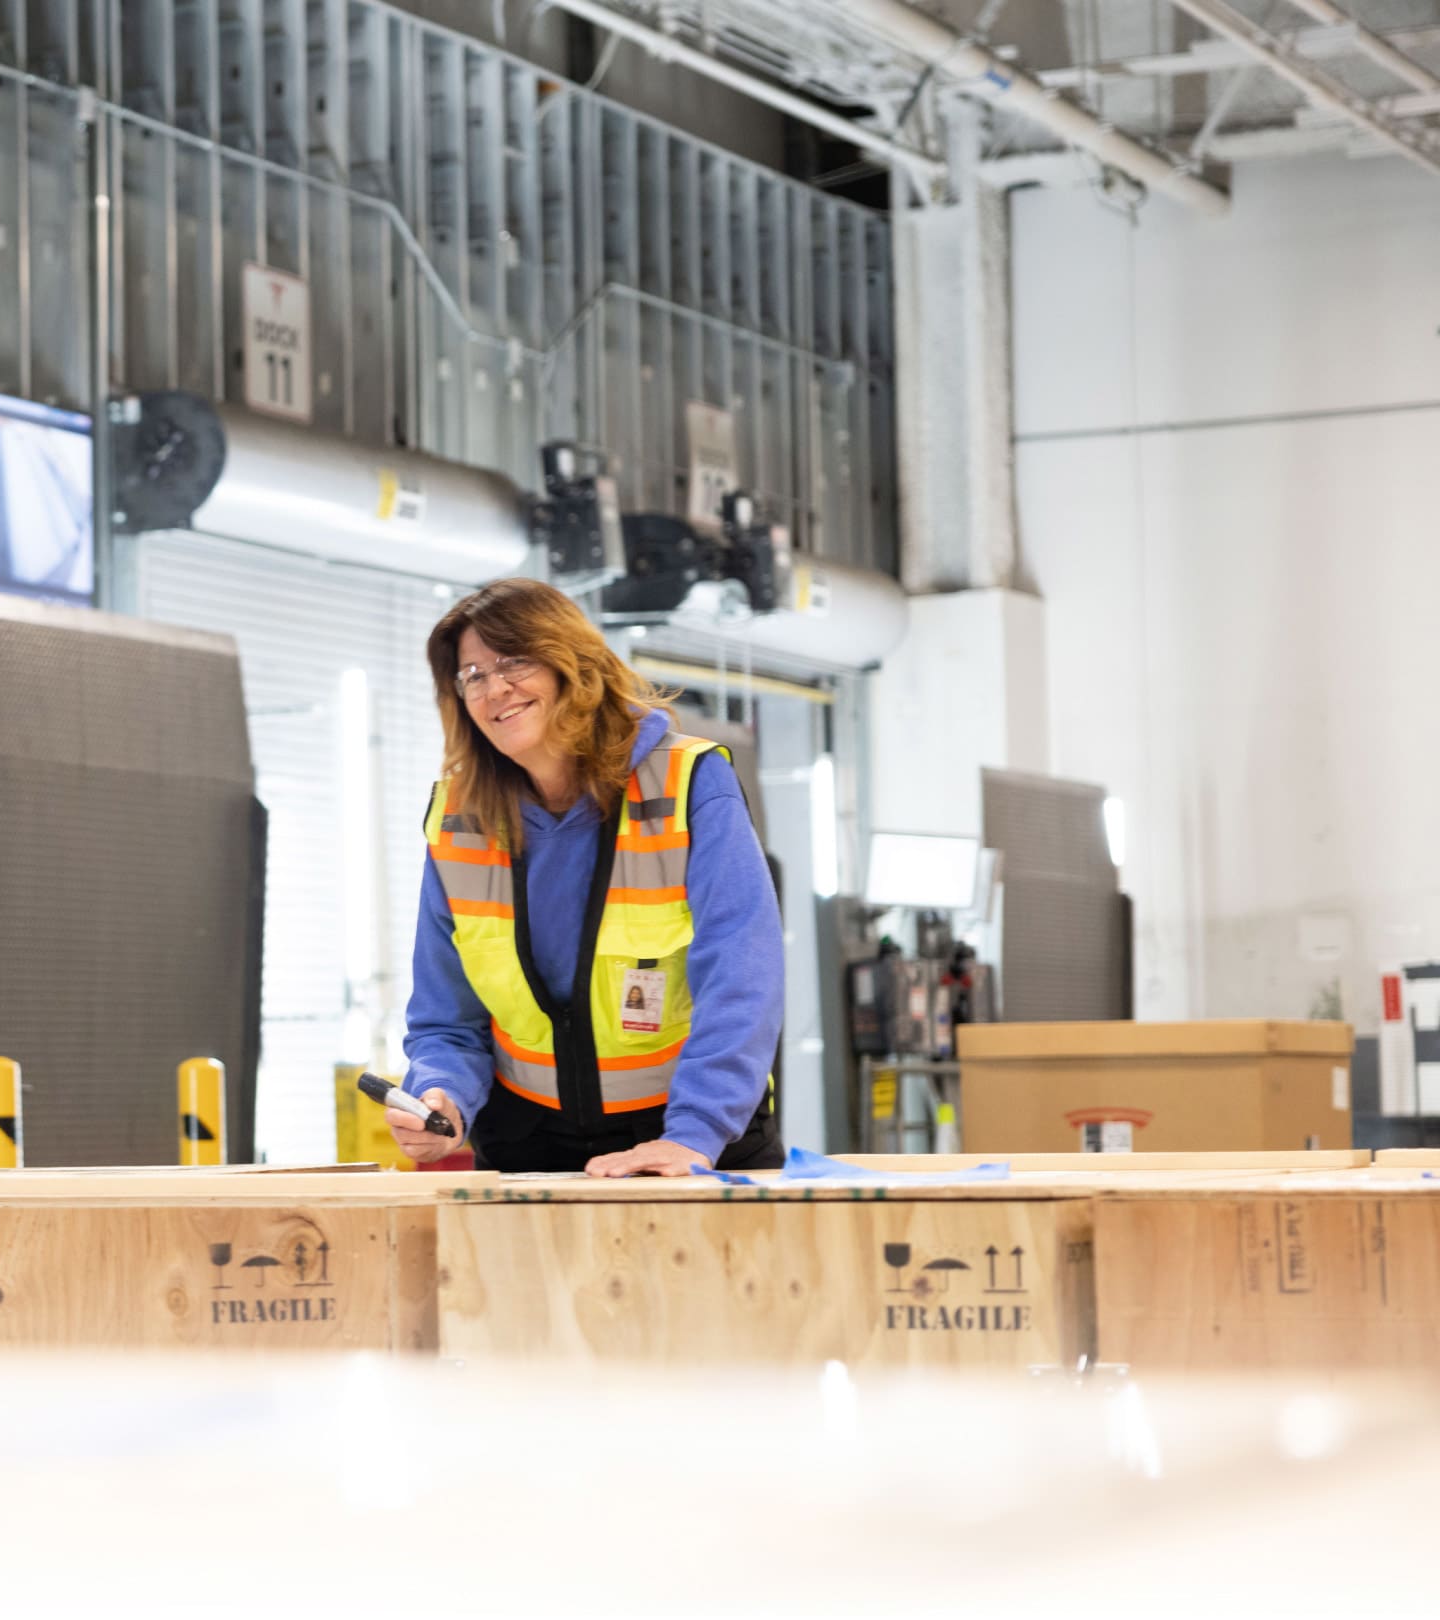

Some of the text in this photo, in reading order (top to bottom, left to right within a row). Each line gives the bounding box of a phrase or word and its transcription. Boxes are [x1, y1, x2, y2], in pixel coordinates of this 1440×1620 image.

[254, 315, 302, 353] DOCK
[264, 352, 294, 406] 11
[211, 1297, 338, 1324] FRAGILE
[885, 1304, 1032, 1331] FRAGILE
